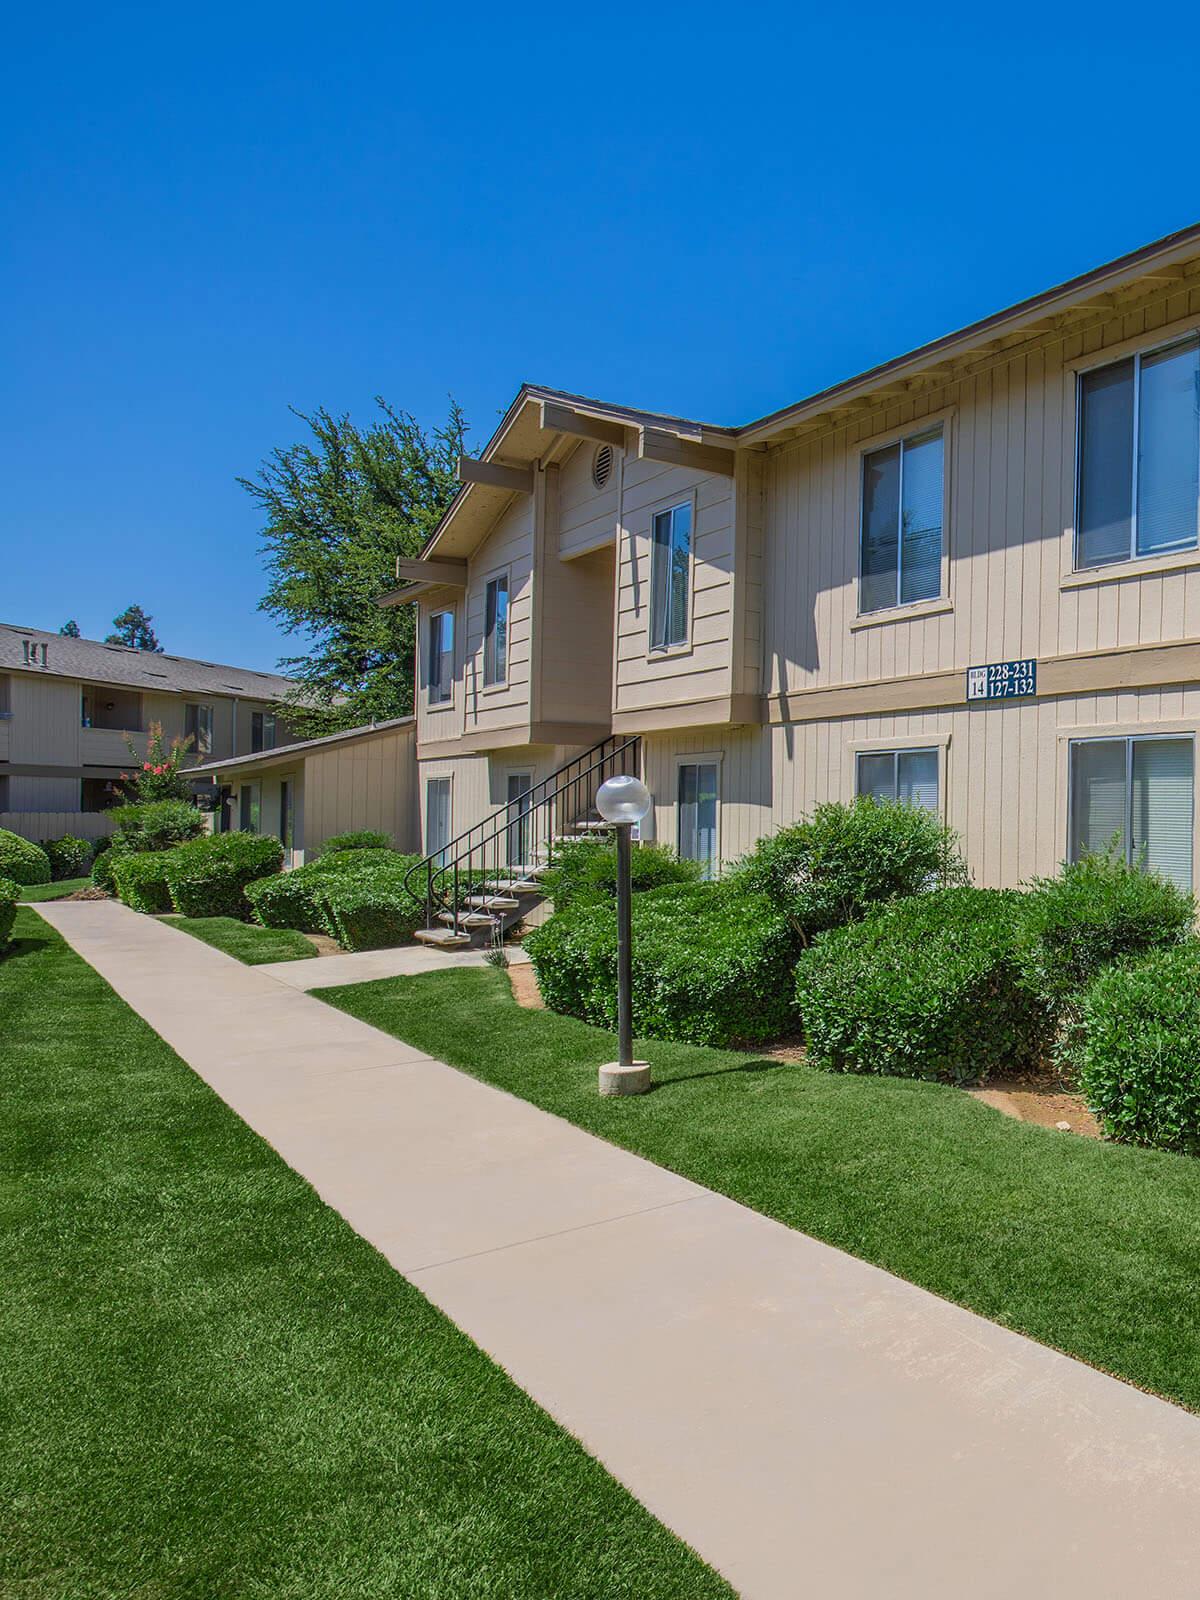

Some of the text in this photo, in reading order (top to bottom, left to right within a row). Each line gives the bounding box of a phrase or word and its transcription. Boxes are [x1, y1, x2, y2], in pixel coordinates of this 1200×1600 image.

[989, 662, 1033, 681] 228-231
[973, 681, 984, 696] 14
[990, 678, 1034, 697] 127-132
